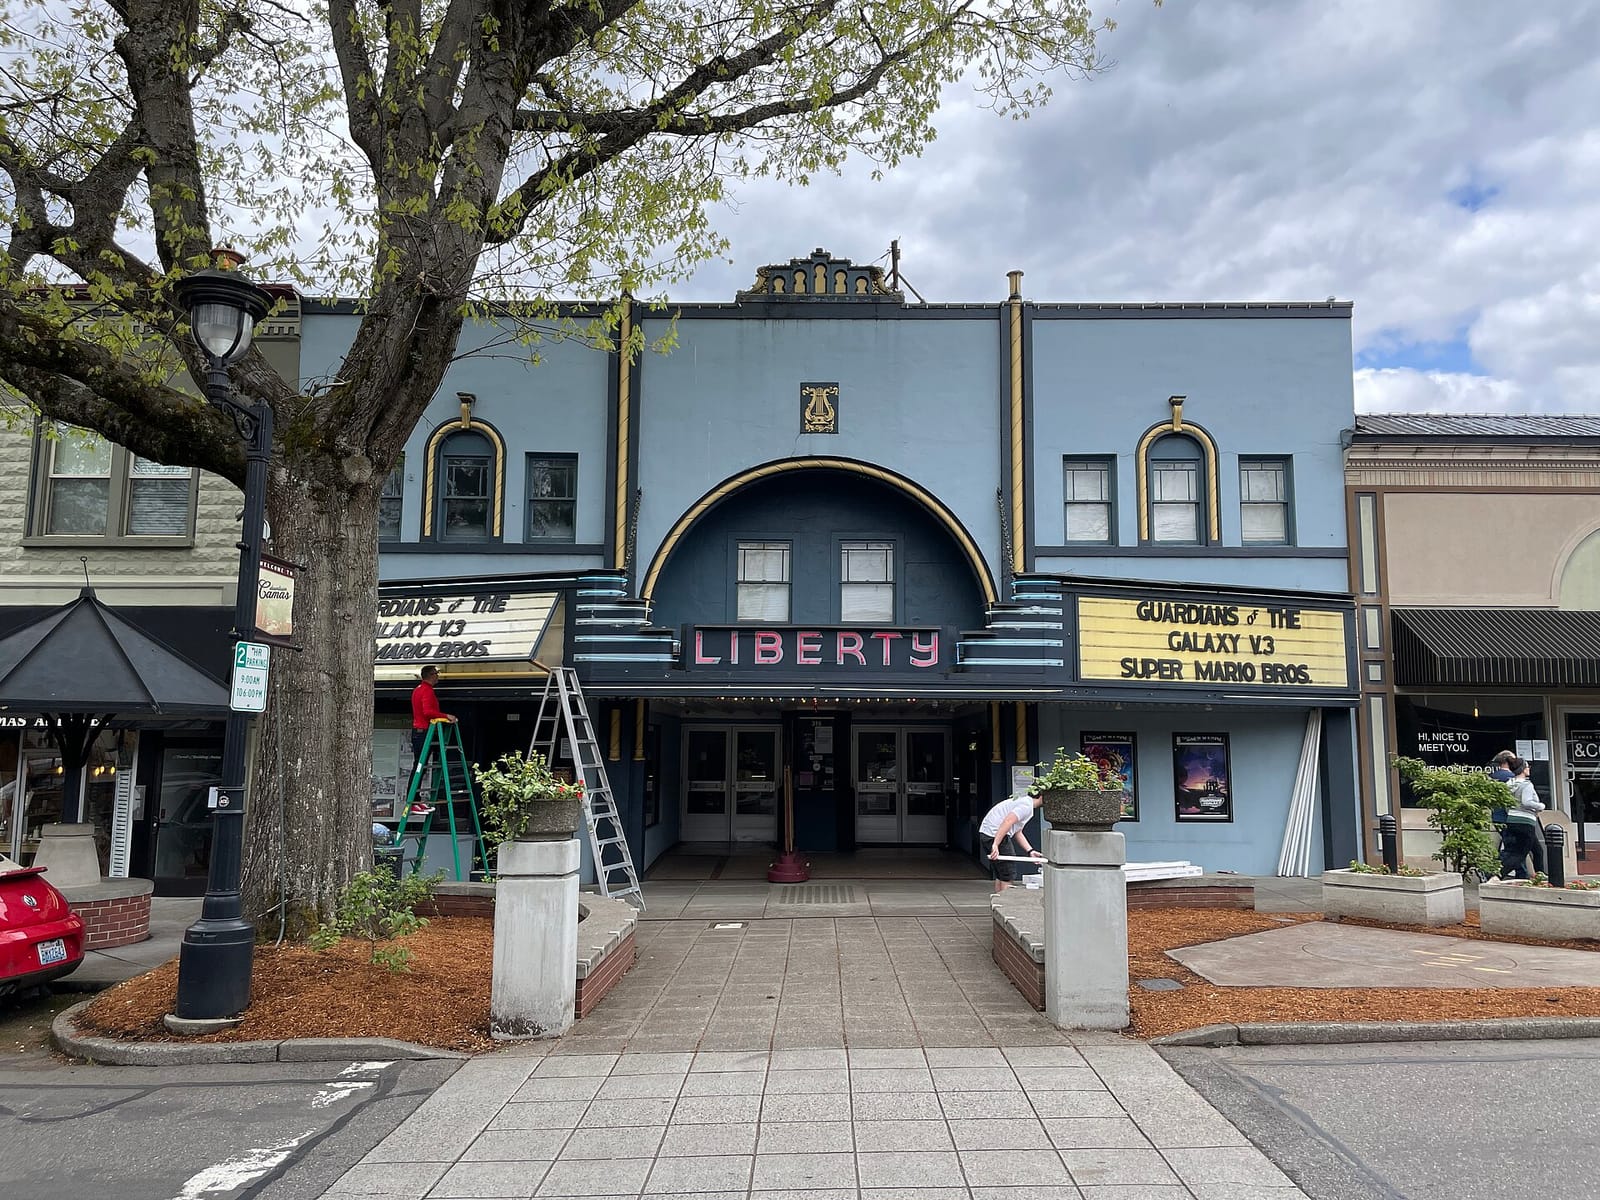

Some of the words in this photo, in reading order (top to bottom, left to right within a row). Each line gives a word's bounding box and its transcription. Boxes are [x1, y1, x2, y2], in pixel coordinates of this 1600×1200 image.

[258, 579, 291, 600] Camas
[377, 598, 443, 617] RDIANS
[472, 594, 511, 614] THE
[1136, 600, 1239, 626] GUARDIANS
[1267, 607, 1301, 629] THE
[375, 620, 433, 638] LAXY
[433, 640, 492, 658] BROS.
[695, 630, 939, 667] LIBERTY
[1168, 631, 1241, 653] GALAXY
[1249, 635, 1275, 656] V.3
[237, 647, 246, 664] 2
[253, 648, 263, 656] HR
[246, 657, 267, 668] PARKING
[1120, 657, 1184, 680] SUPER
[1194, 660, 1256, 682] MARIO
[1261, 663, 1313, 684] BROS.
[1418, 732, 1430, 742] HI,
[1432, 732, 1454, 741] NICE
[1456, 732, 1469, 741] TO
[1418, 743, 1444, 752] MEET
[1446, 743, 1469, 753] YOU.
[1574, 743, 1600, 758] &C
